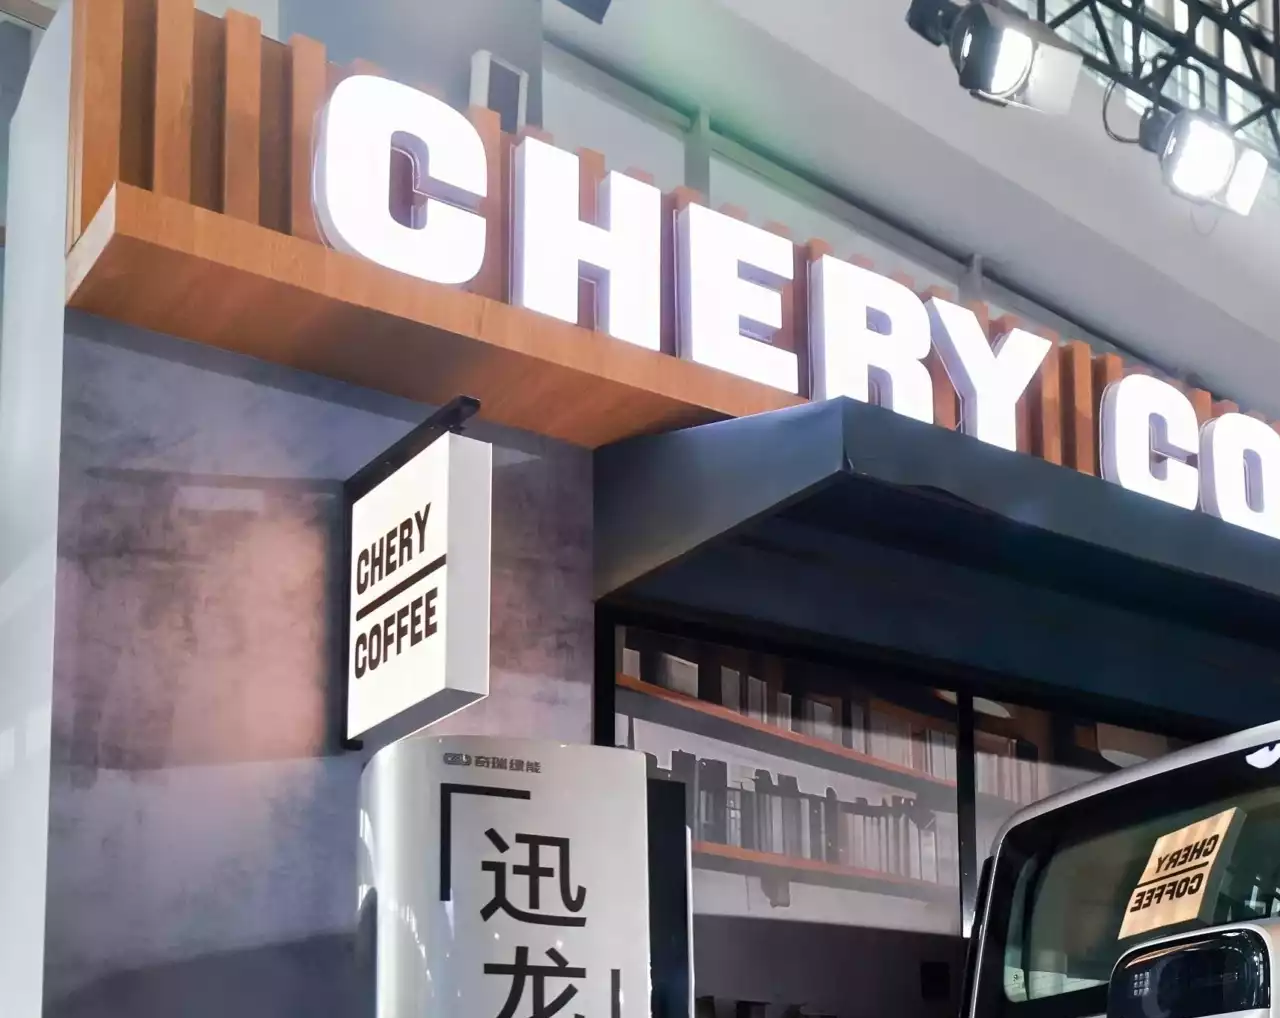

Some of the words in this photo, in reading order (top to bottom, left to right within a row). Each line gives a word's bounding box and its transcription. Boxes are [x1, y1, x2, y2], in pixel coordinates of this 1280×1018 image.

[314, 74, 1052, 453] CHERY
[356, 501, 432, 595] CHERY
[354, 586, 439, 680] COFFEE
